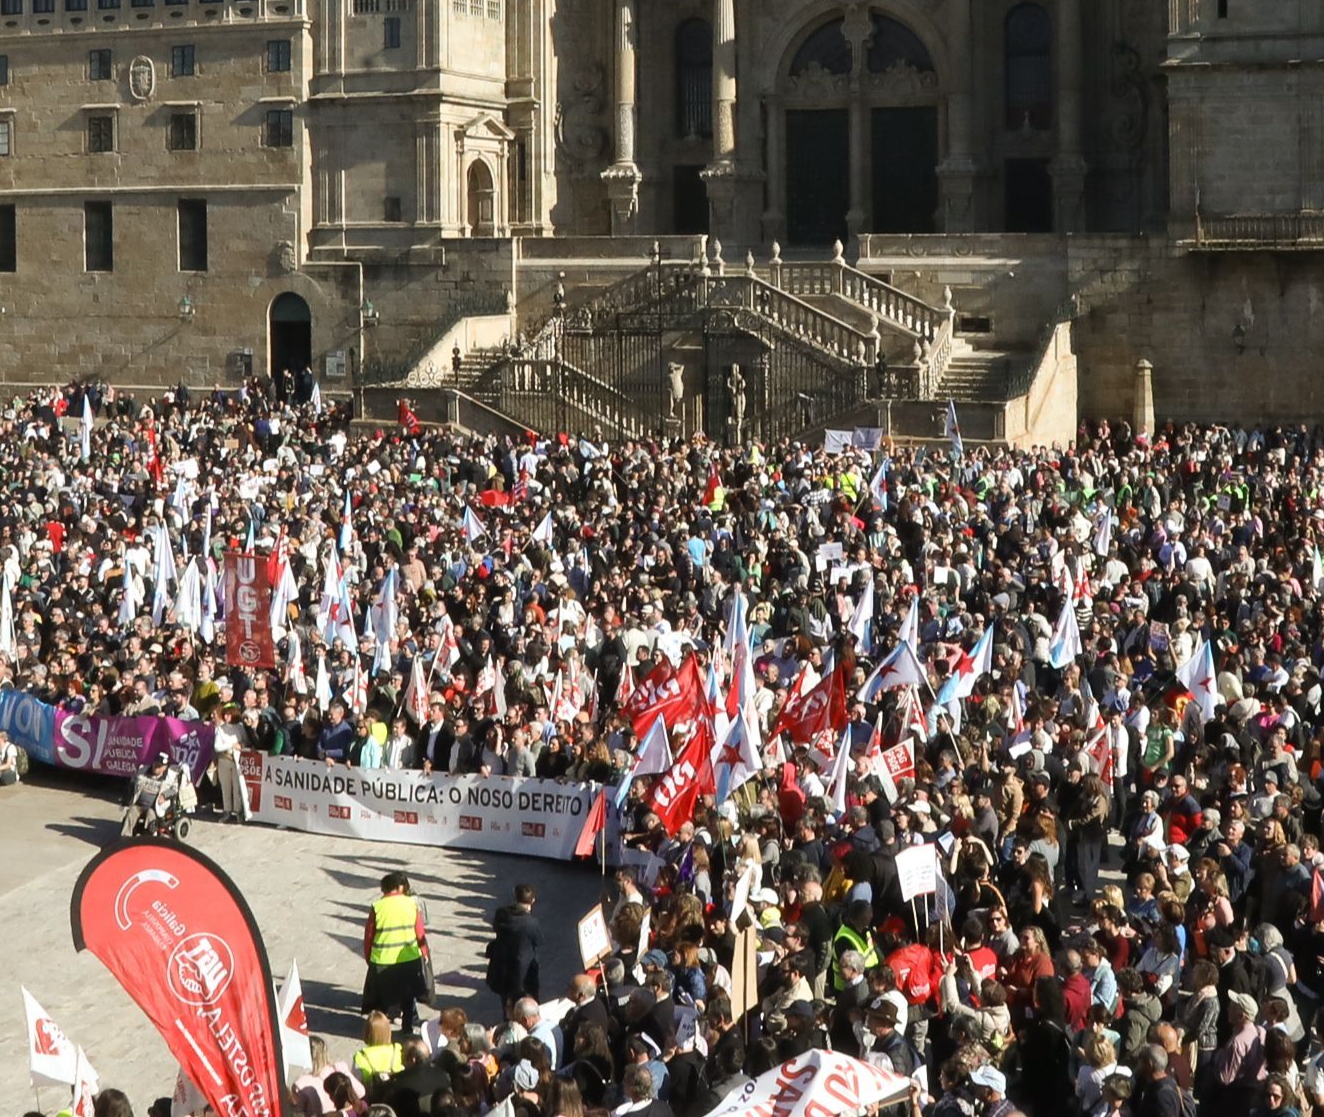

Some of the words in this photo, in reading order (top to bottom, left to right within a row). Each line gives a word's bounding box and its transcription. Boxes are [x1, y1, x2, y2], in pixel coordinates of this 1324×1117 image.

[237, 558, 257, 639] UGT
[264, 765, 272, 783] A
[275, 768, 356, 795] SANIDADE
[361, 777, 444, 804] PÚBLICA:
[448, 787, 462, 804] O
[467, 787, 513, 810] NOSO
[518, 794, 583, 816] DEREITO
